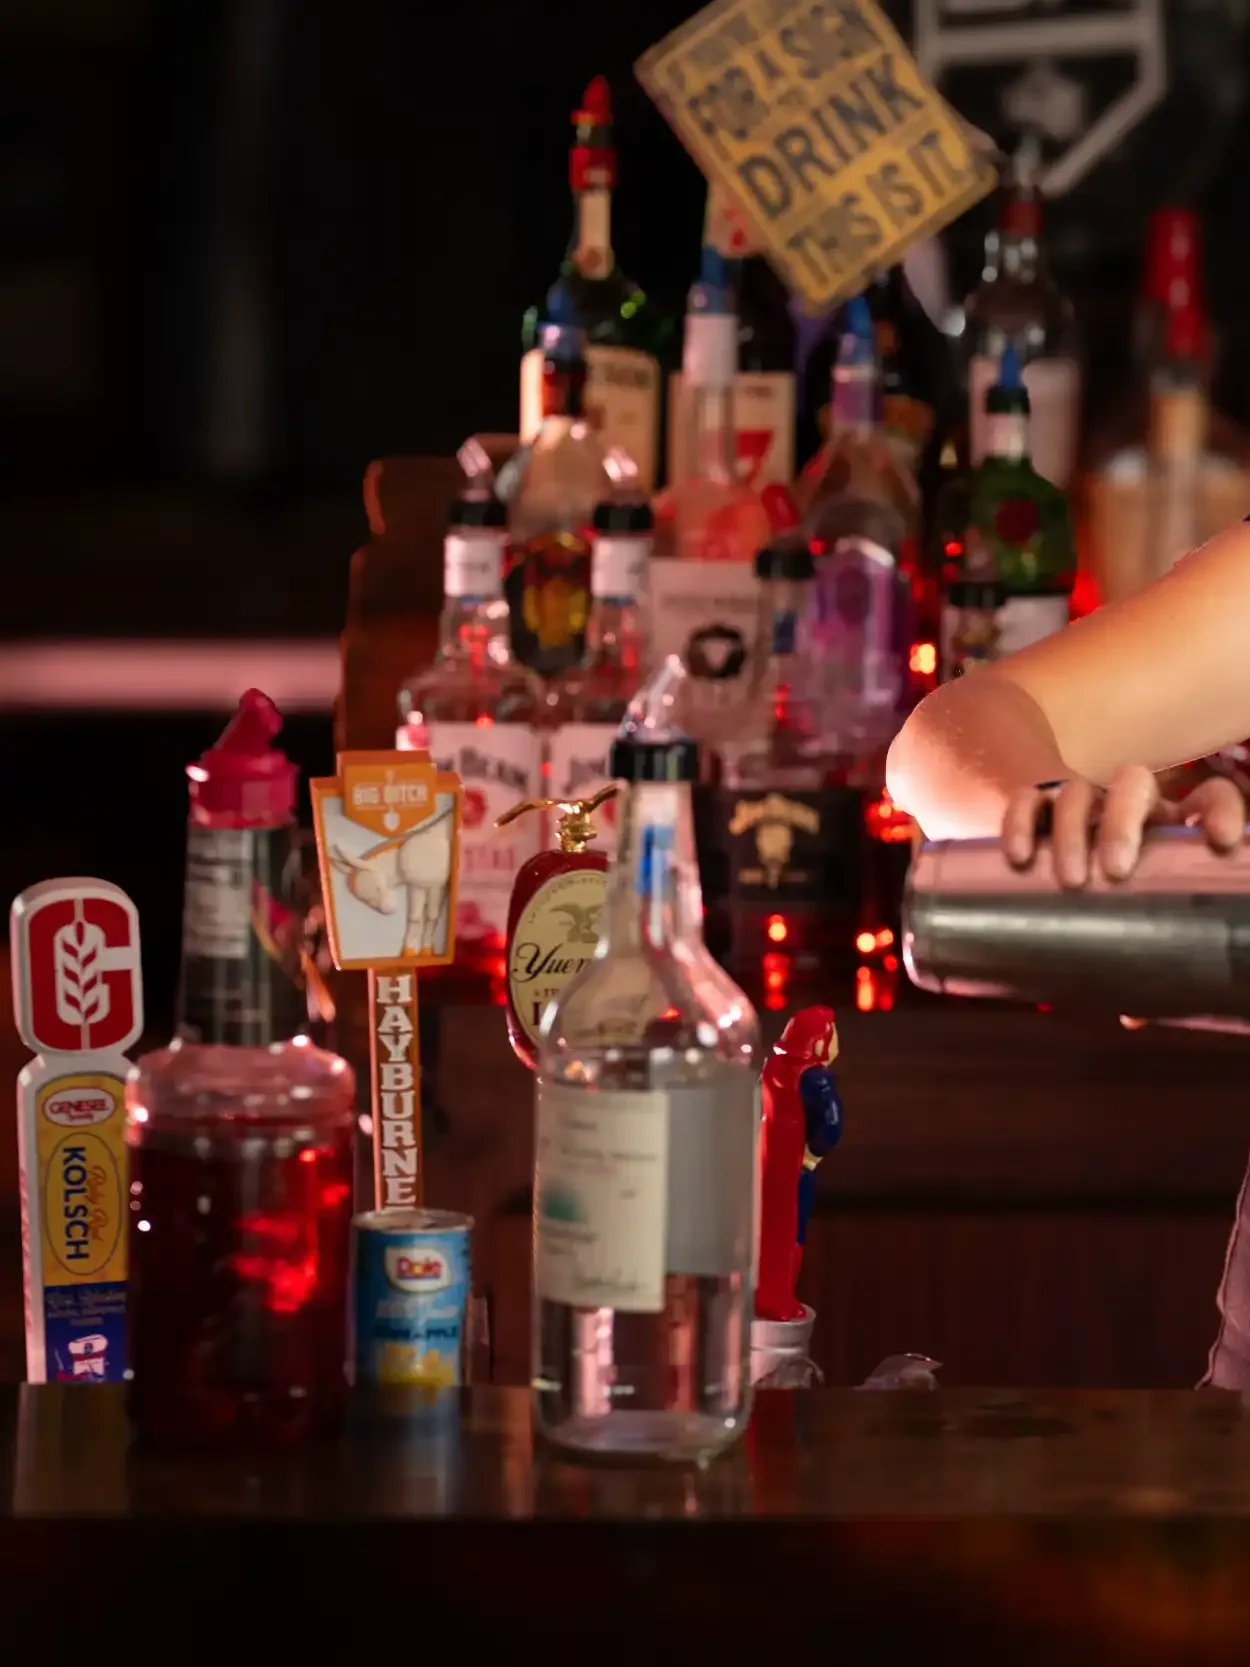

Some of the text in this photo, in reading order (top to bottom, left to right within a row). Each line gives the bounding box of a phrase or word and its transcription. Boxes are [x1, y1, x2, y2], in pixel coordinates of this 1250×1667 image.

[736, 54, 922, 219] DRINK
[376, 975, 418, 1211] HAYBURNE
[64, 1146, 90, 1260] KOLSCH
[396, 1256, 442, 1277] Dole
